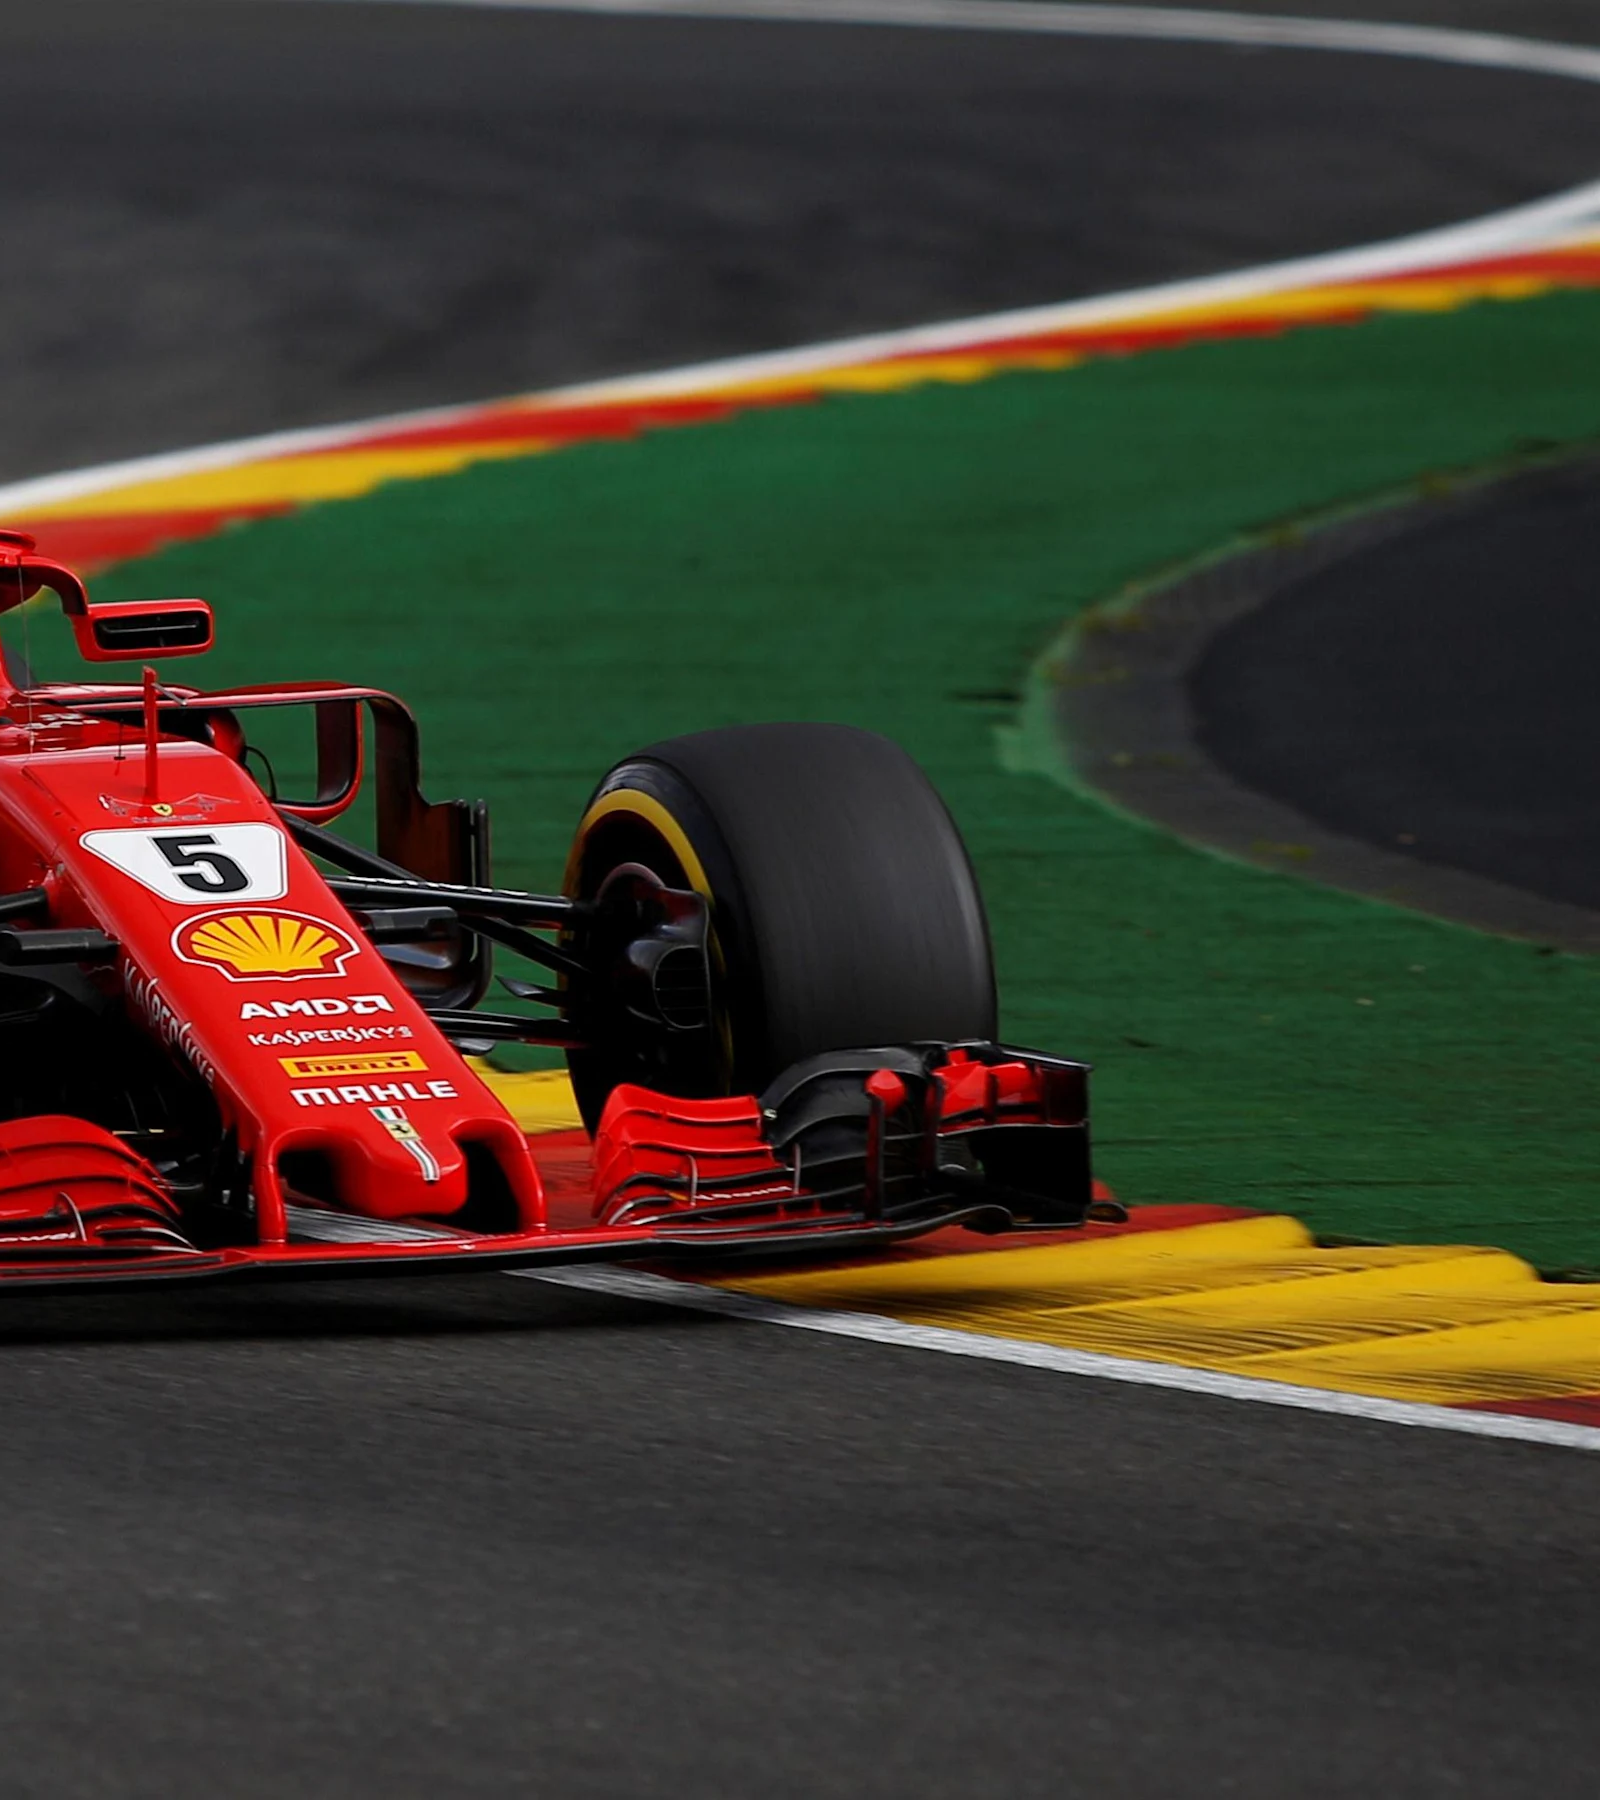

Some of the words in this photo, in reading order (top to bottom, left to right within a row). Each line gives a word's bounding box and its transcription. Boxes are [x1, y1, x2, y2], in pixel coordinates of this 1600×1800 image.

[151, 834, 250, 893] 5
[240, 998, 349, 1020] AMD
[247, 1026, 396, 1047] KASPERSKY
[293, 1056, 414, 1074] PIRELLI
[290, 1080, 460, 1107] MAHLE
